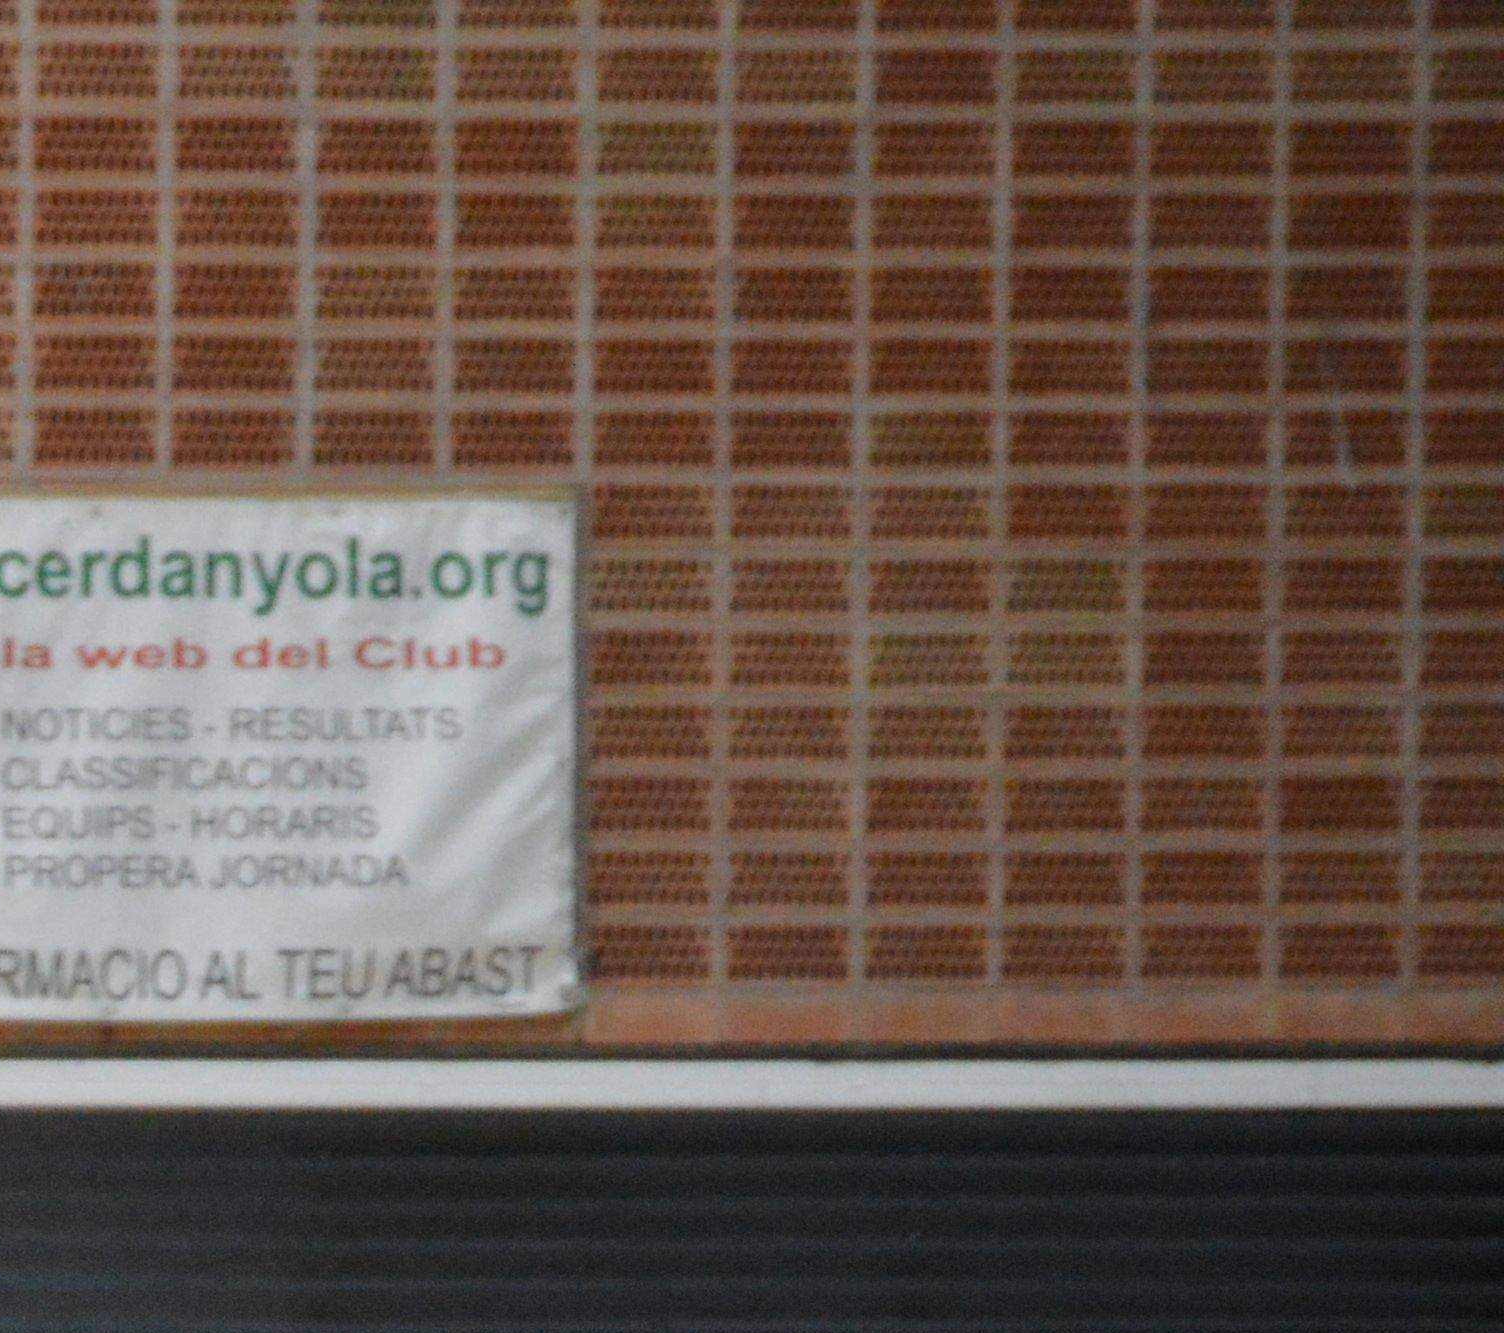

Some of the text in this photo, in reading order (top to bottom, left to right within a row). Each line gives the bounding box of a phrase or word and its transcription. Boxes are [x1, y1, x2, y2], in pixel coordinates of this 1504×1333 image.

[2, 634, 53, 670] la
[78, 637, 207, 670] web
[232, 637, 329, 670] del
[354, 636, 507, 670] Club
[2, 706, 193, 743] NOTICIES
[228, 707, 465, 743] RESULTATS
[0, 756, 368, 791] CLASSIFICACIONS
[3, 805, 158, 842] EQUIPS
[190, 806, 380, 842] HORARIS
[4, 854, 412, 890] PROPERA JORNADA
[199, 949, 264, 1001] AL
[276, 947, 378, 1001] TEU
[385, 945, 546, 999] ABAST
